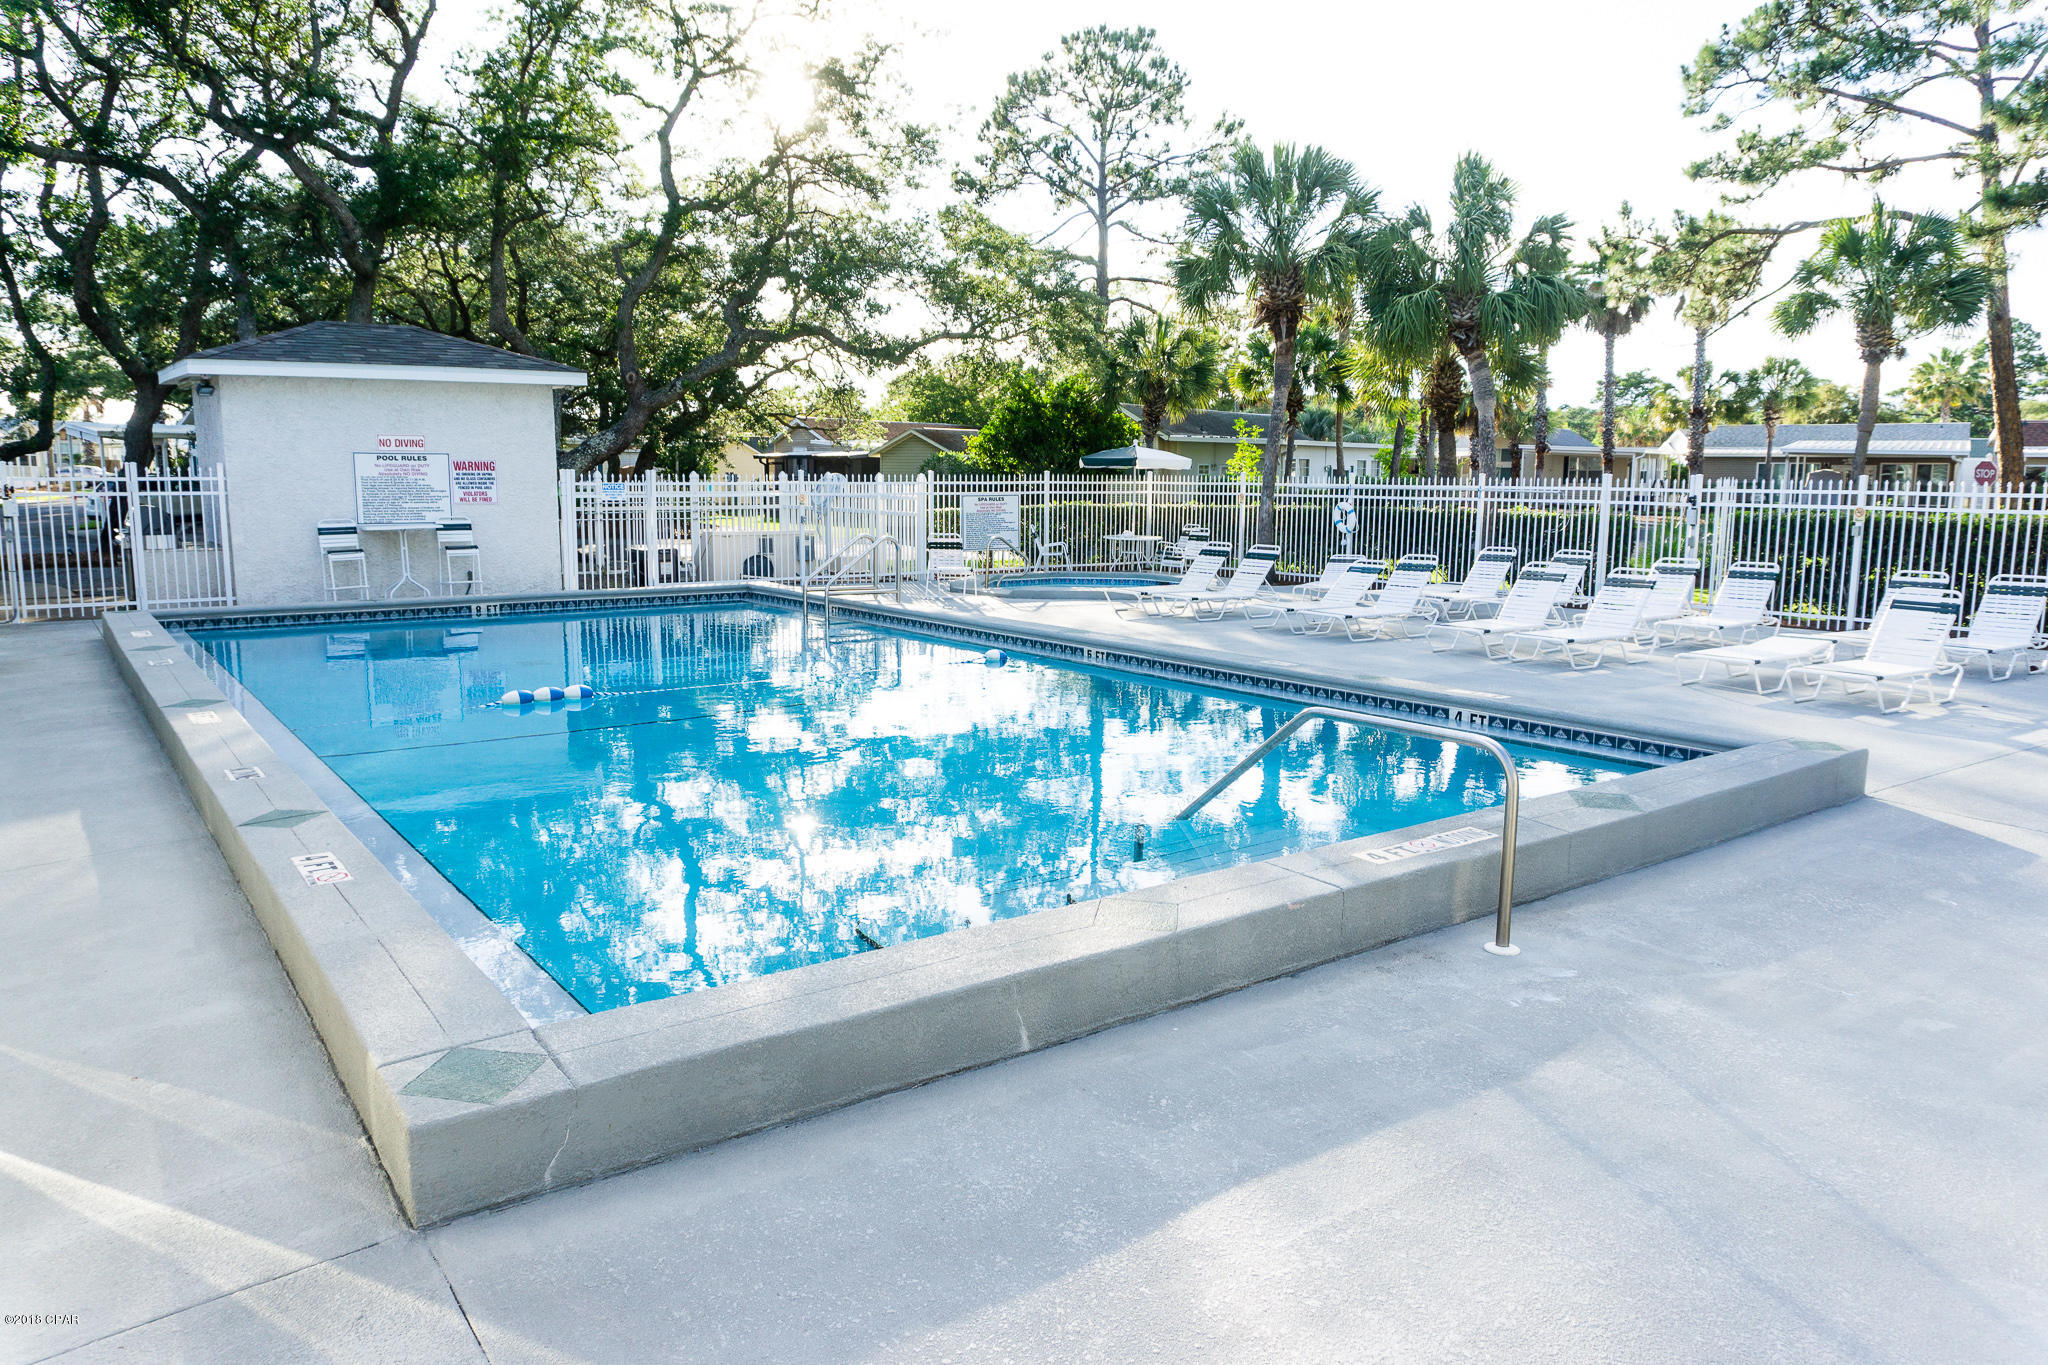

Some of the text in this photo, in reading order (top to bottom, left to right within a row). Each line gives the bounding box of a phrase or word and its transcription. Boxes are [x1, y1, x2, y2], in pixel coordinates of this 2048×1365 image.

[378, 438, 424, 448] NO DIVING
[453, 461, 495, 471] WARNING
[1975, 468, 1995, 478] STOP
[1470, 713, 1487, 725] FT
